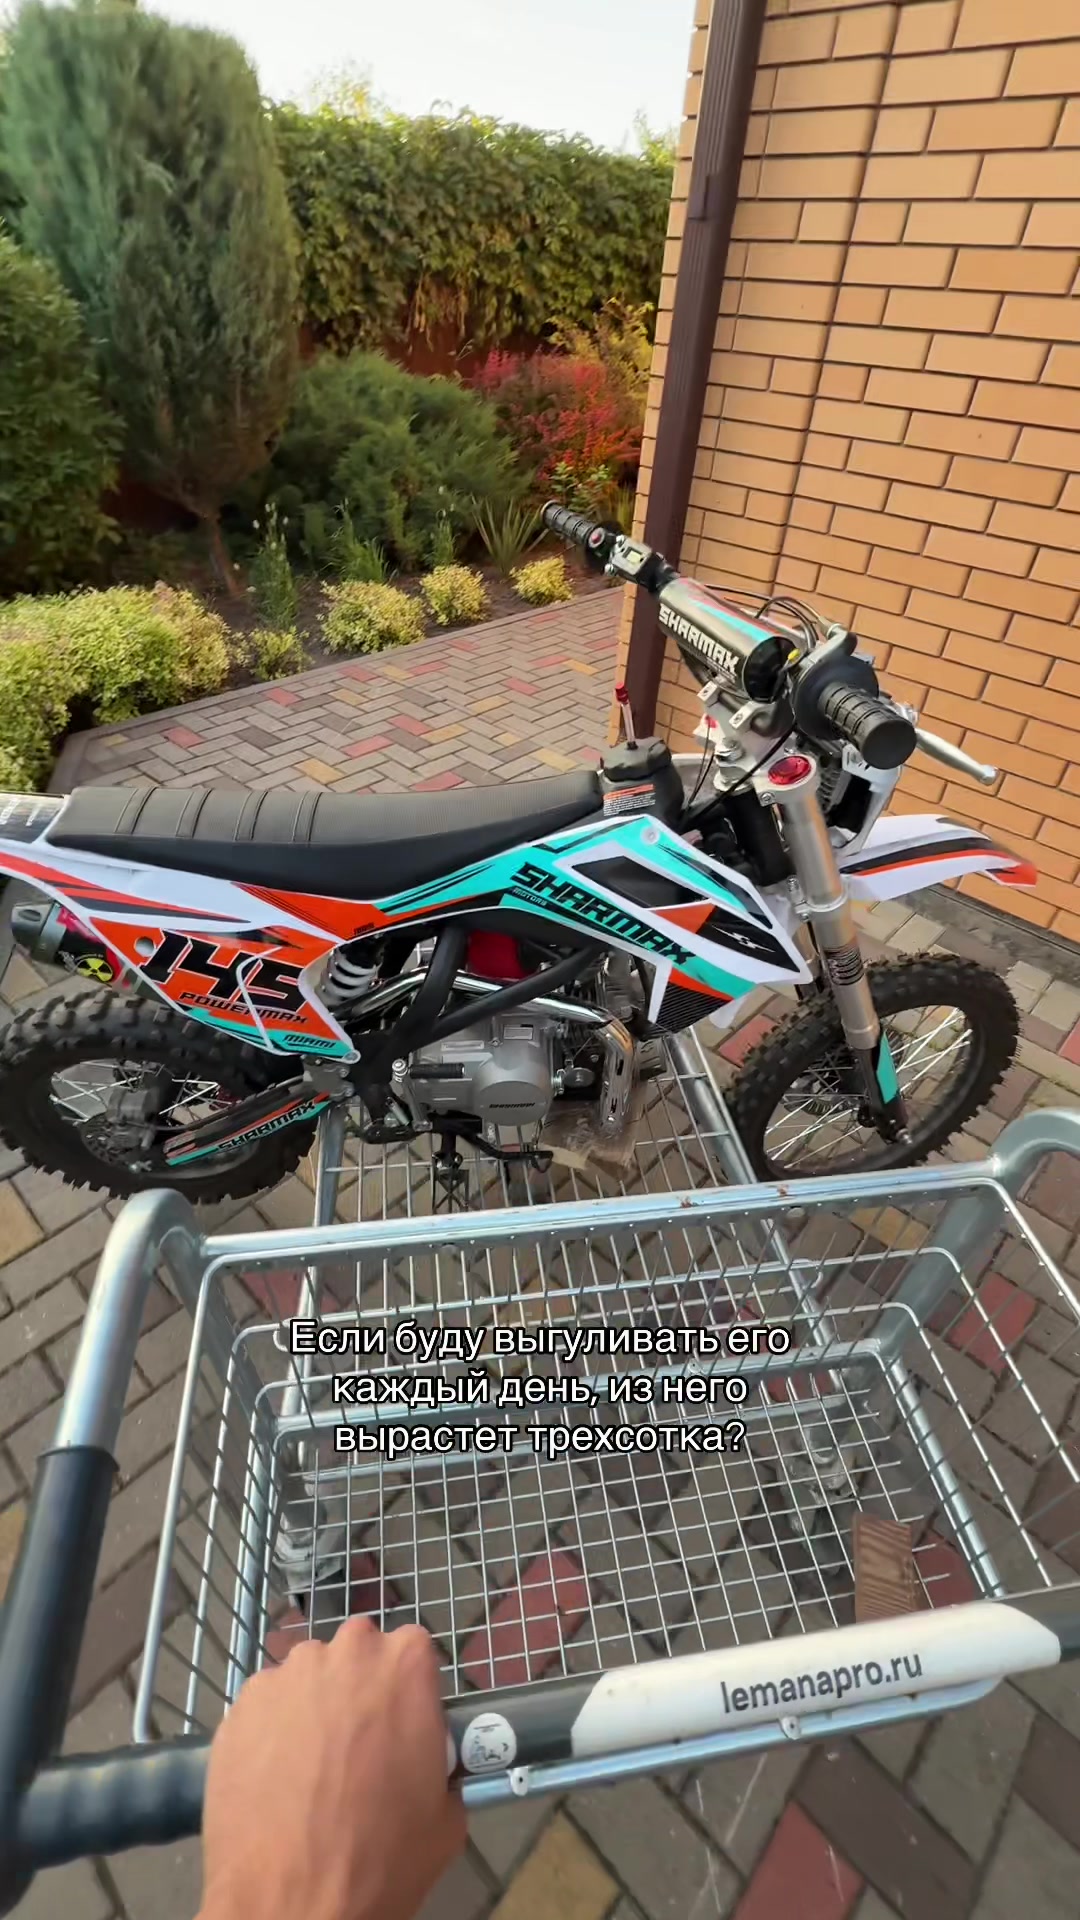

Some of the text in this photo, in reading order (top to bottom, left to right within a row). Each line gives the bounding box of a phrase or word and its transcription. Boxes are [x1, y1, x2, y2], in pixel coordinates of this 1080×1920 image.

[659, 603, 739, 675] SHARMAX
[510, 862, 696, 965] SHARMAX
[511, 887, 548, 907] MOTORS
[138, 930, 306, 1013] 145
[283, 1033, 337, 1049] MIAMI
[218, 1100, 316, 1150] SHARMAX
[720, 1654, 923, 1713] lemanapro.ru
